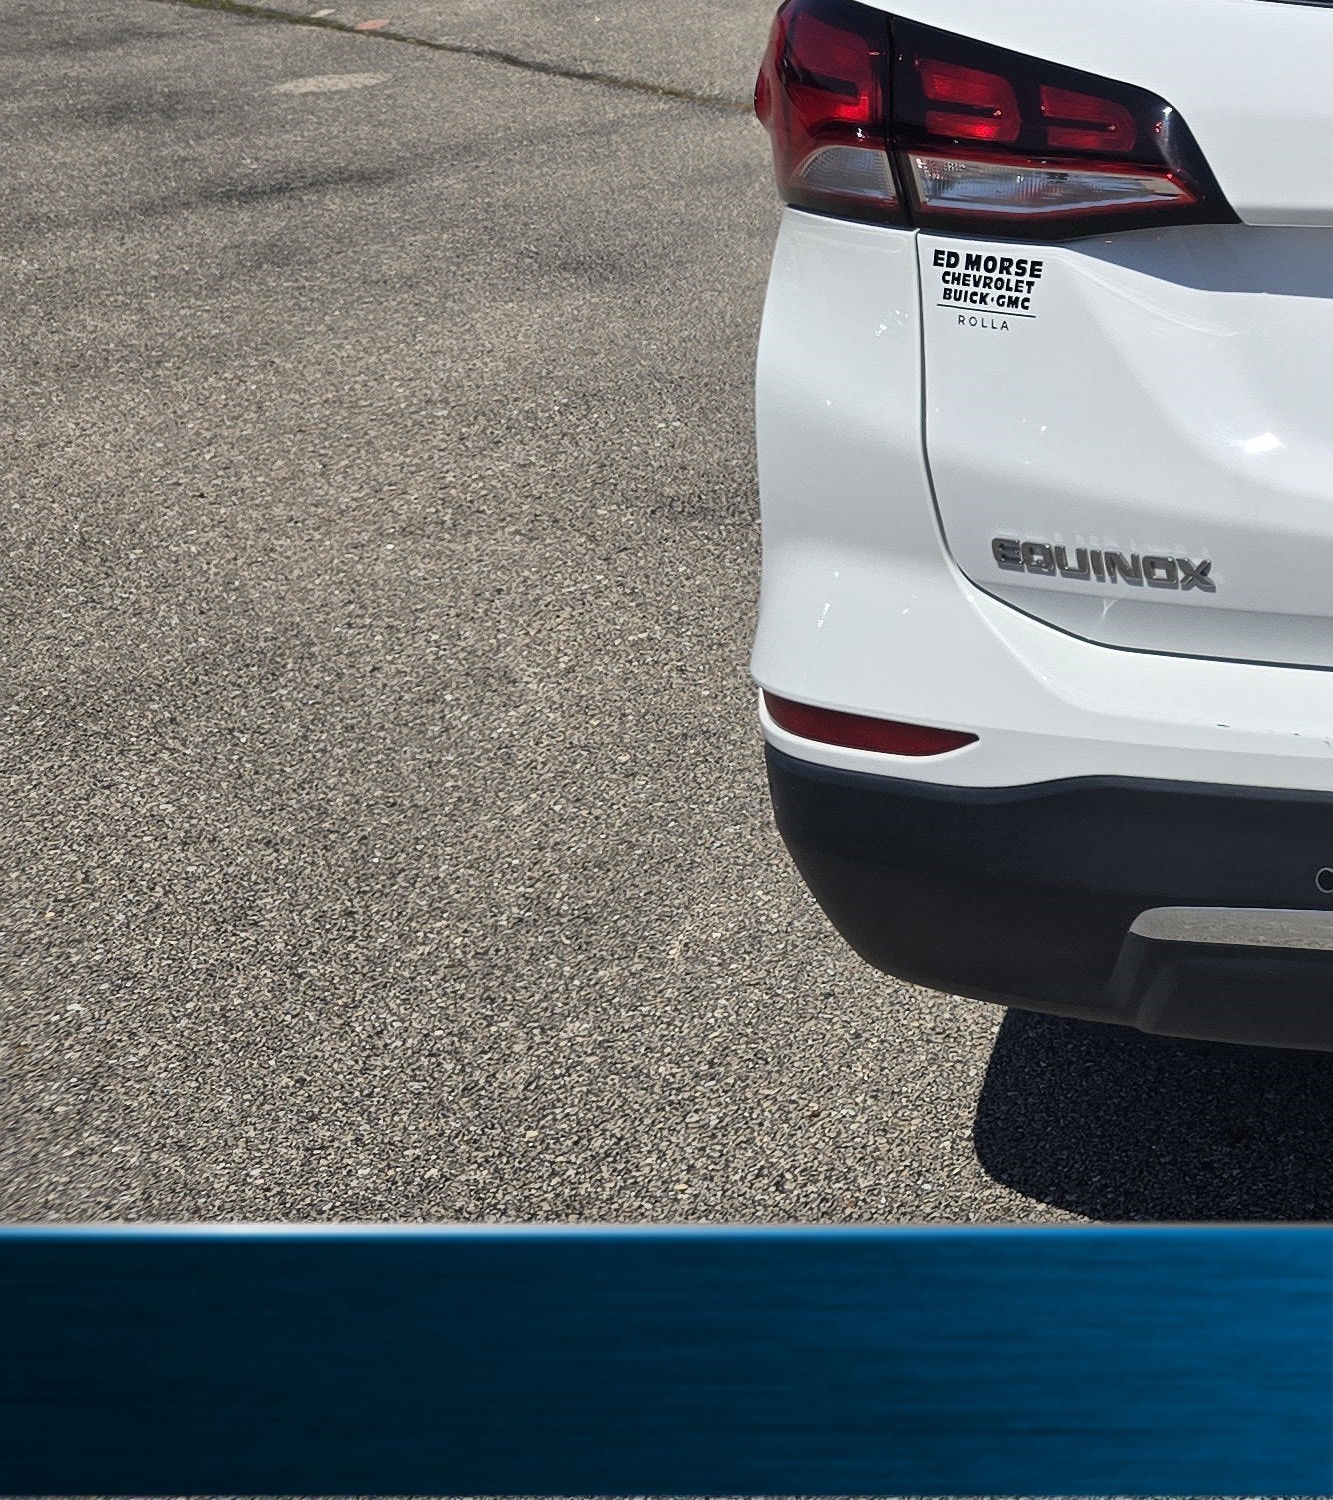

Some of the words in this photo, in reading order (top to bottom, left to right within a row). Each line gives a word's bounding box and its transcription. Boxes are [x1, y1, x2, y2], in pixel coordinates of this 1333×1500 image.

[933, 249, 960, 269] ED
[965, 253, 1043, 278] MORSE
[941, 271, 1035, 294] CHEVROLET
[958, 315, 1009, 331] ROLLA
[992, 537, 1216, 593] EQUINOX
